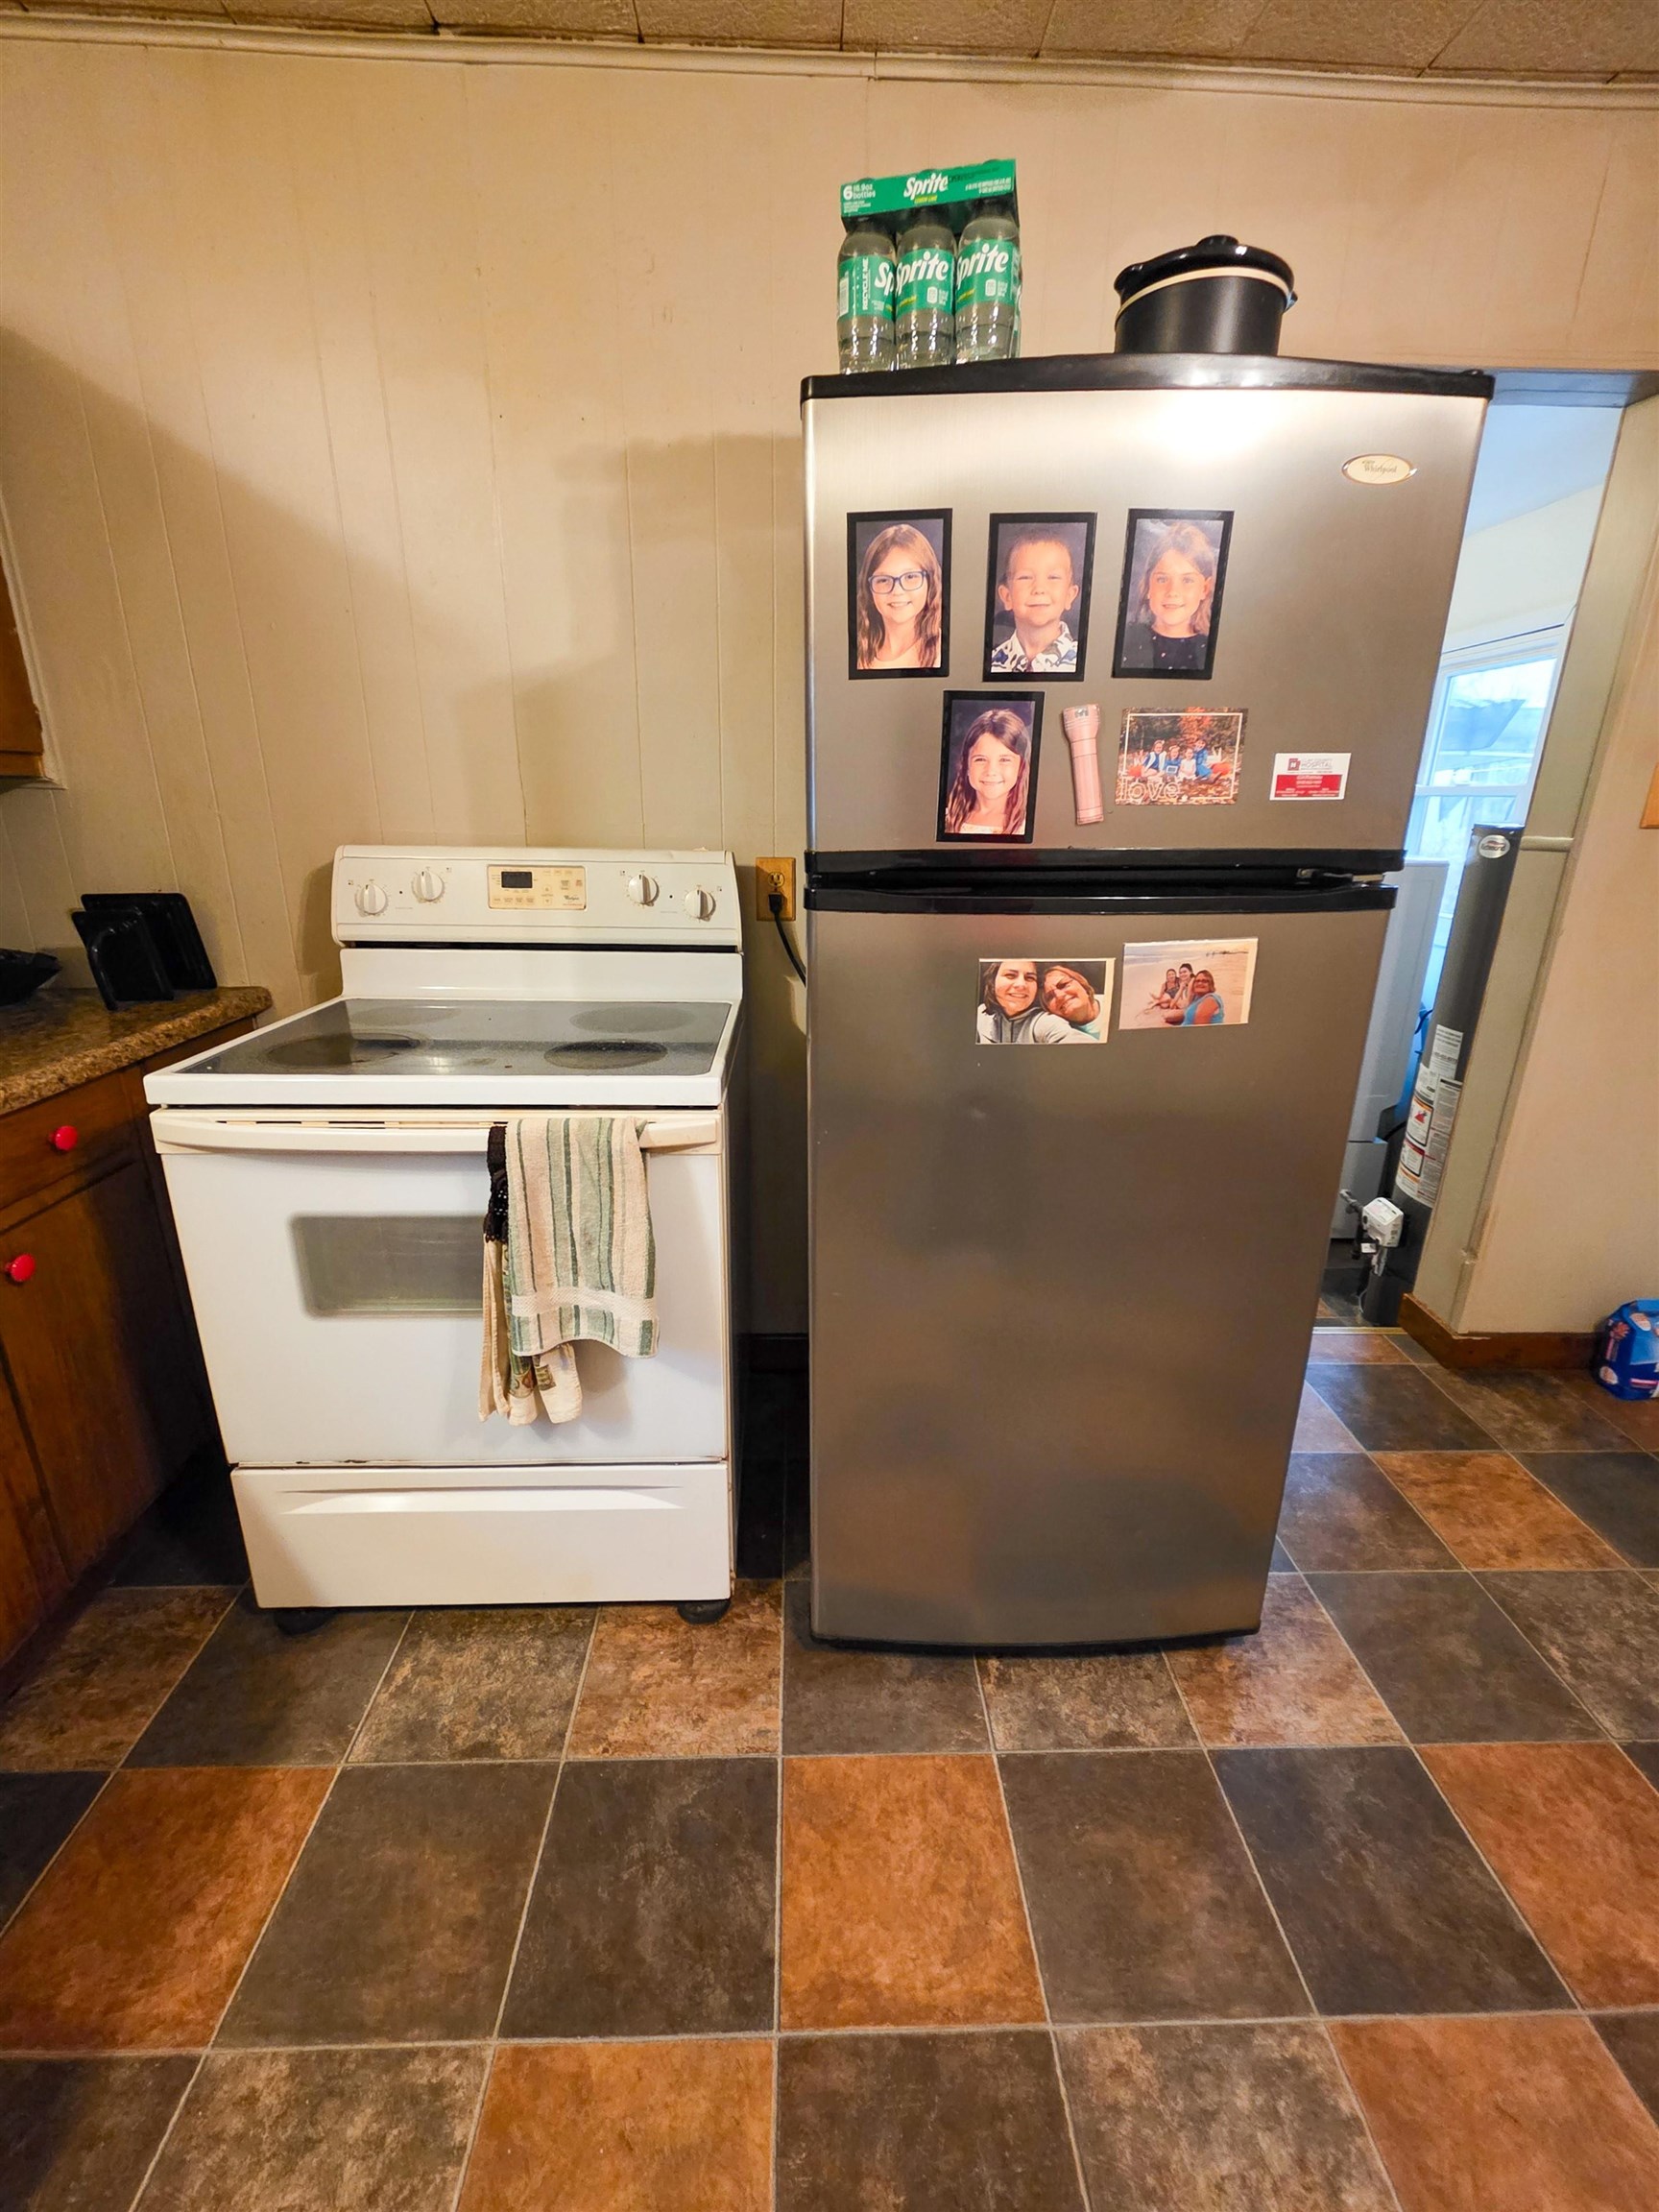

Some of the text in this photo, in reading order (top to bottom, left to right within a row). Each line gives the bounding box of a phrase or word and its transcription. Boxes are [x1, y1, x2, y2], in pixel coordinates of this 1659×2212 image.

[843, 184, 854, 201] 6
[853, 189, 876, 200] bottles
[903, 172, 949, 201] Sprite
